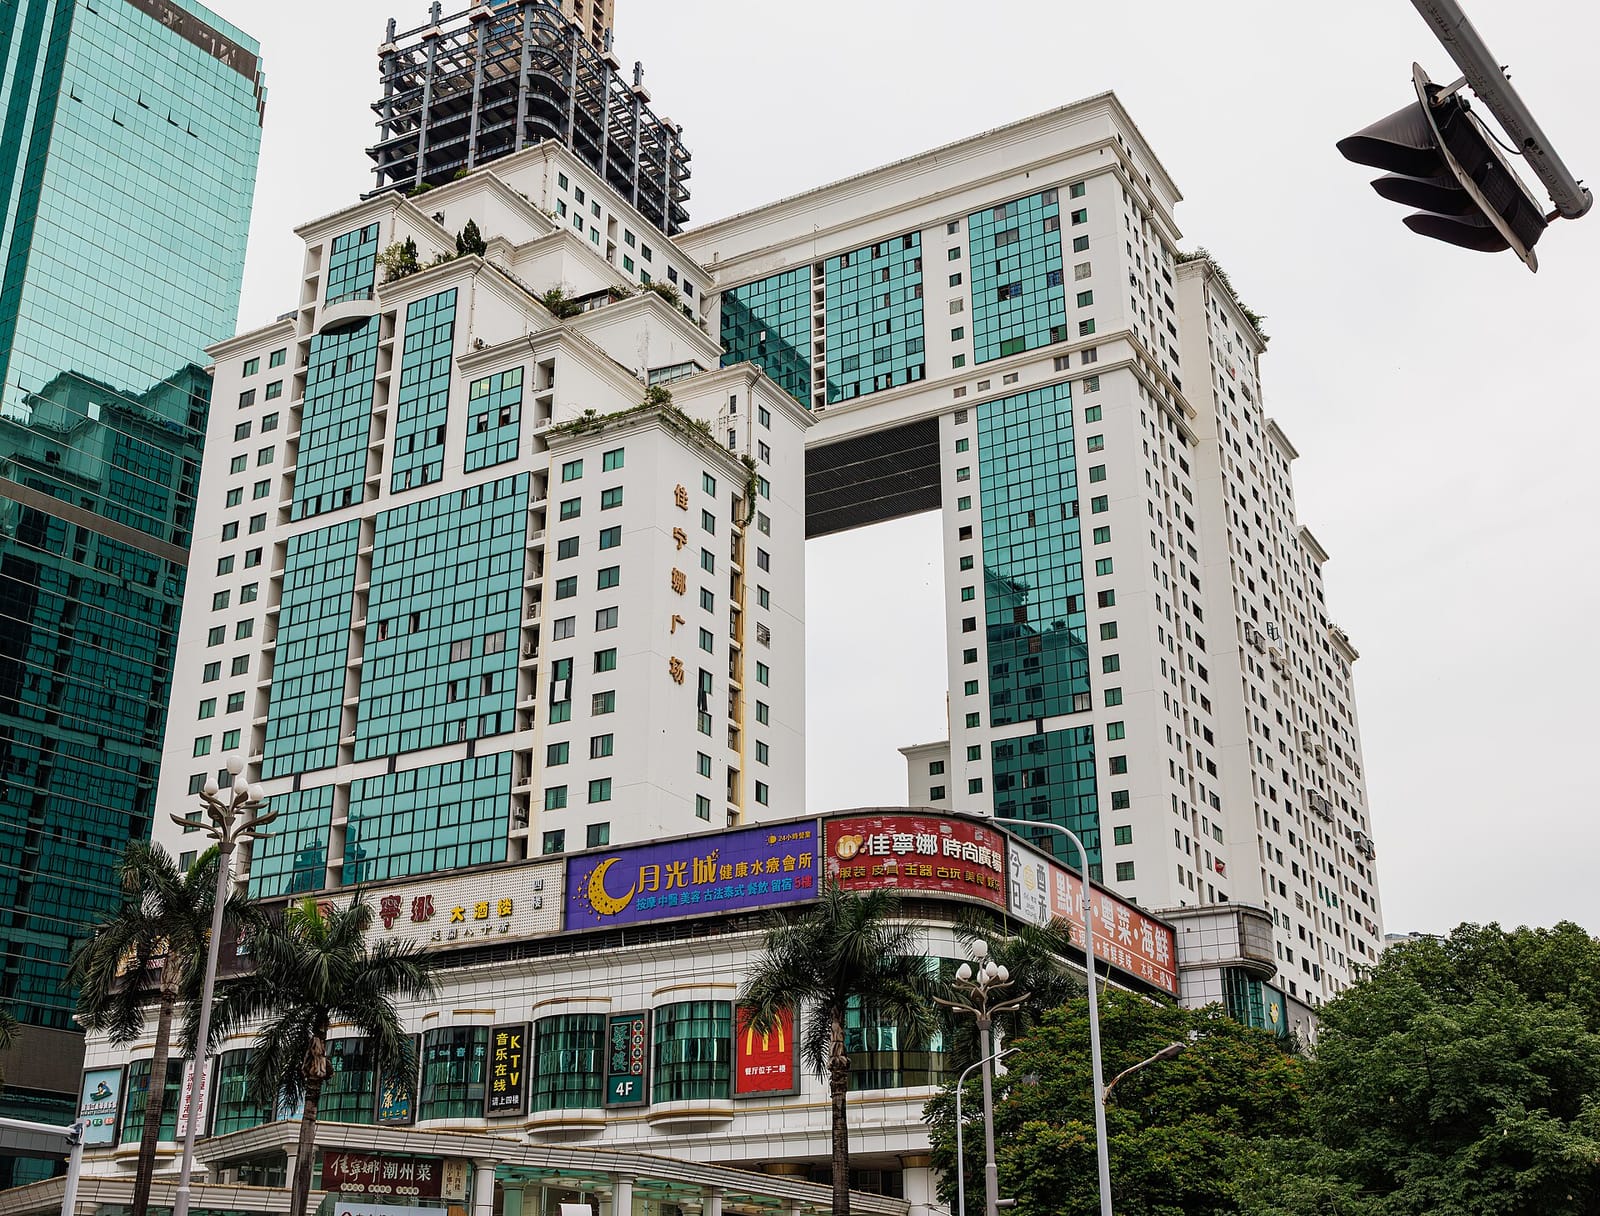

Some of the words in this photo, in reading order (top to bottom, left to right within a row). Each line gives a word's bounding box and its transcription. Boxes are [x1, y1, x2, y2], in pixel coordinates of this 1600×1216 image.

[669, 483, 689, 685] 佳宁娜广场
[637, 855, 716, 894] 月光城
[719, 852, 812, 881] 健康水療會所
[493, 1032, 509, 1092] 音乐在线
[510, 1035, 521, 1086] KTV
[616, 1082, 633, 1096] 4F
